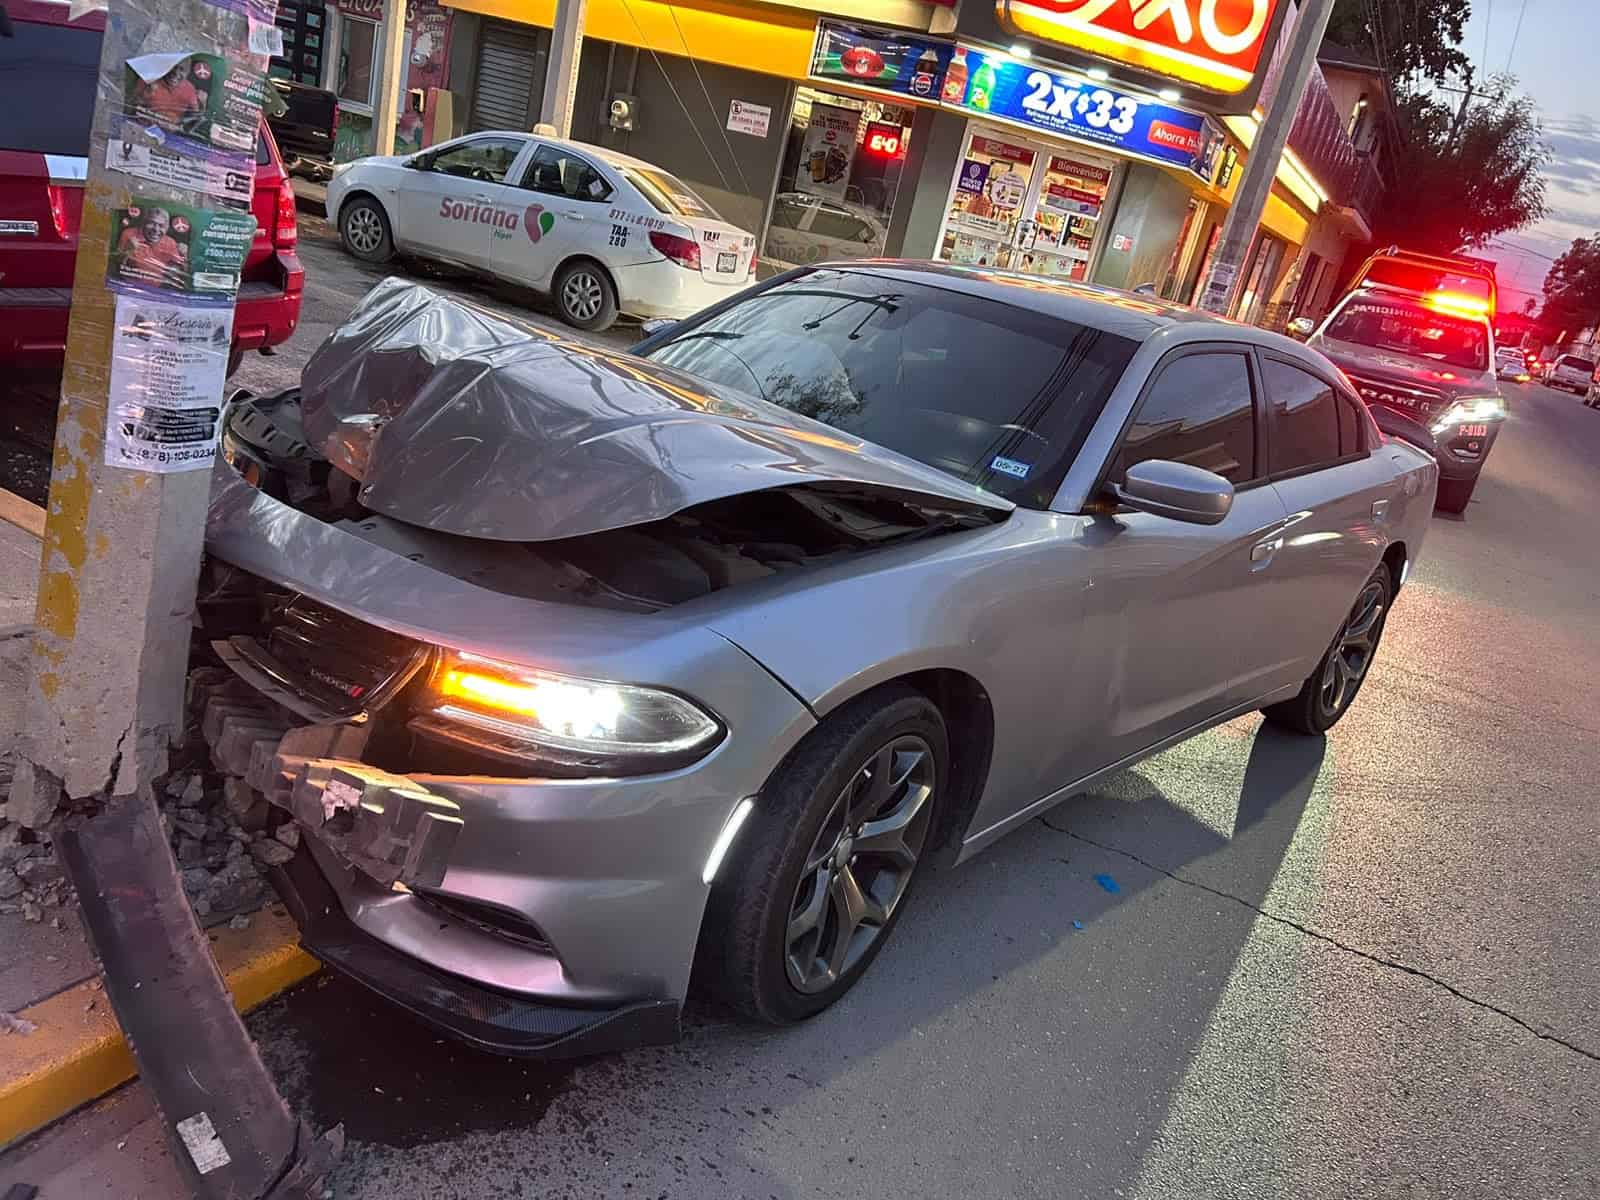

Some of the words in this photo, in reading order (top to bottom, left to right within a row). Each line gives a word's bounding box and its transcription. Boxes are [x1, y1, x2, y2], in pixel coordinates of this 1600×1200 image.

[1153, 128, 1185, 145] Ahorra
[1057, 160, 1103, 180] Bienvenido
[440, 197, 519, 231] Soriana
